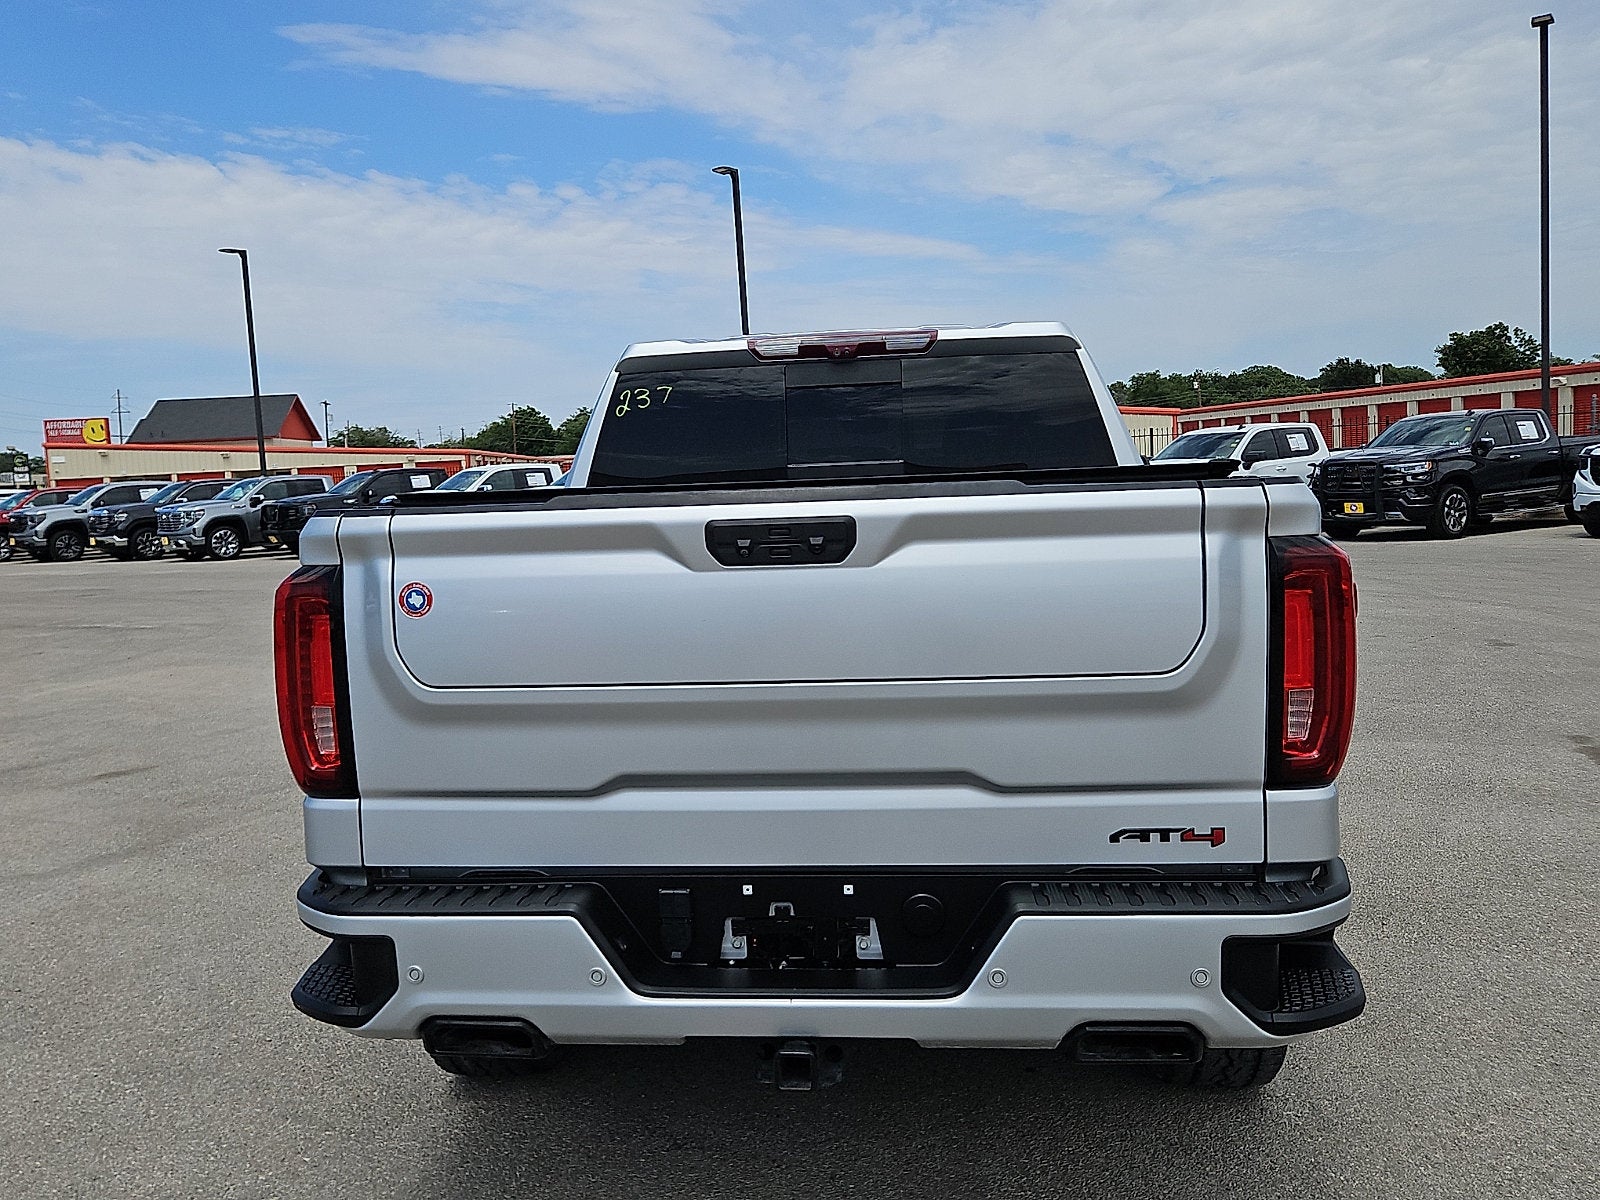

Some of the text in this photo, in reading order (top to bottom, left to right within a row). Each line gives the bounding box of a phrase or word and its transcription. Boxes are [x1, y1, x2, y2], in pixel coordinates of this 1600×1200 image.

[615, 385, 673, 417] 237
[46, 420, 86, 429] AFFORDABLE
[1108, 827, 1226, 848] AT4
